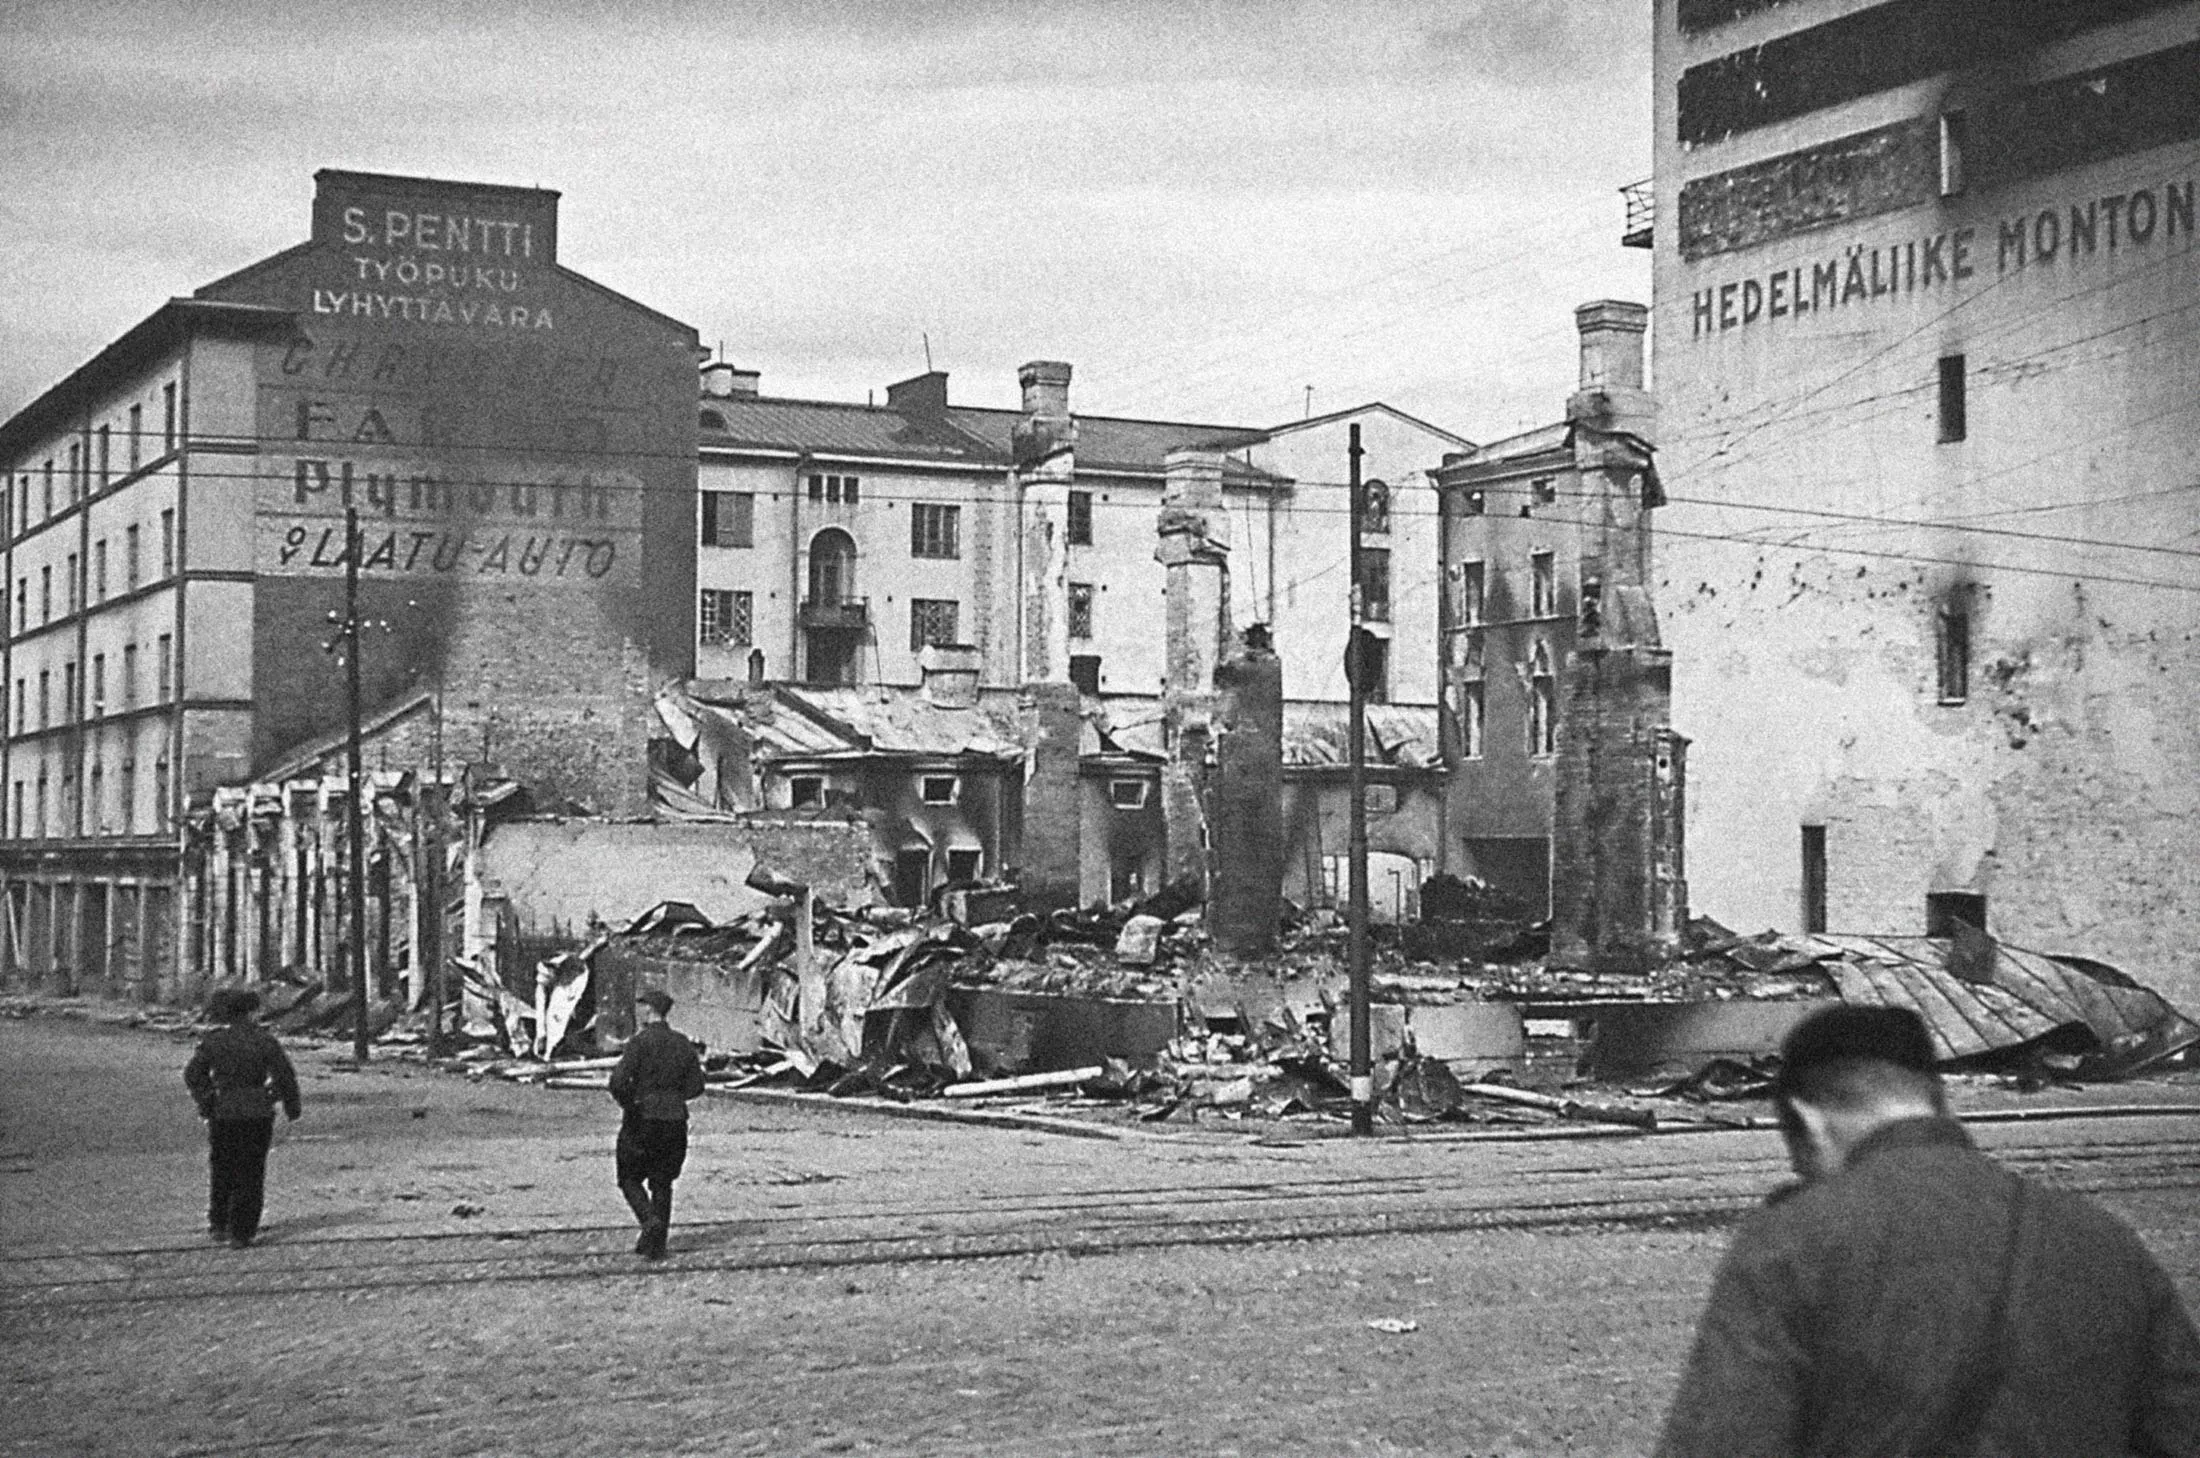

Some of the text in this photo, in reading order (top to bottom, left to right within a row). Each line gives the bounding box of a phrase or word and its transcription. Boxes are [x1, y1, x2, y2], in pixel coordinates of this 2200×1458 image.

[386, 211, 531, 257] PENTTI
[354, 255, 517, 292] TYÖPUKU
[1693, 227, 1976, 336] HEDELMÄLIIKE
[313, 290, 552, 330] LYHYTTAVARA
